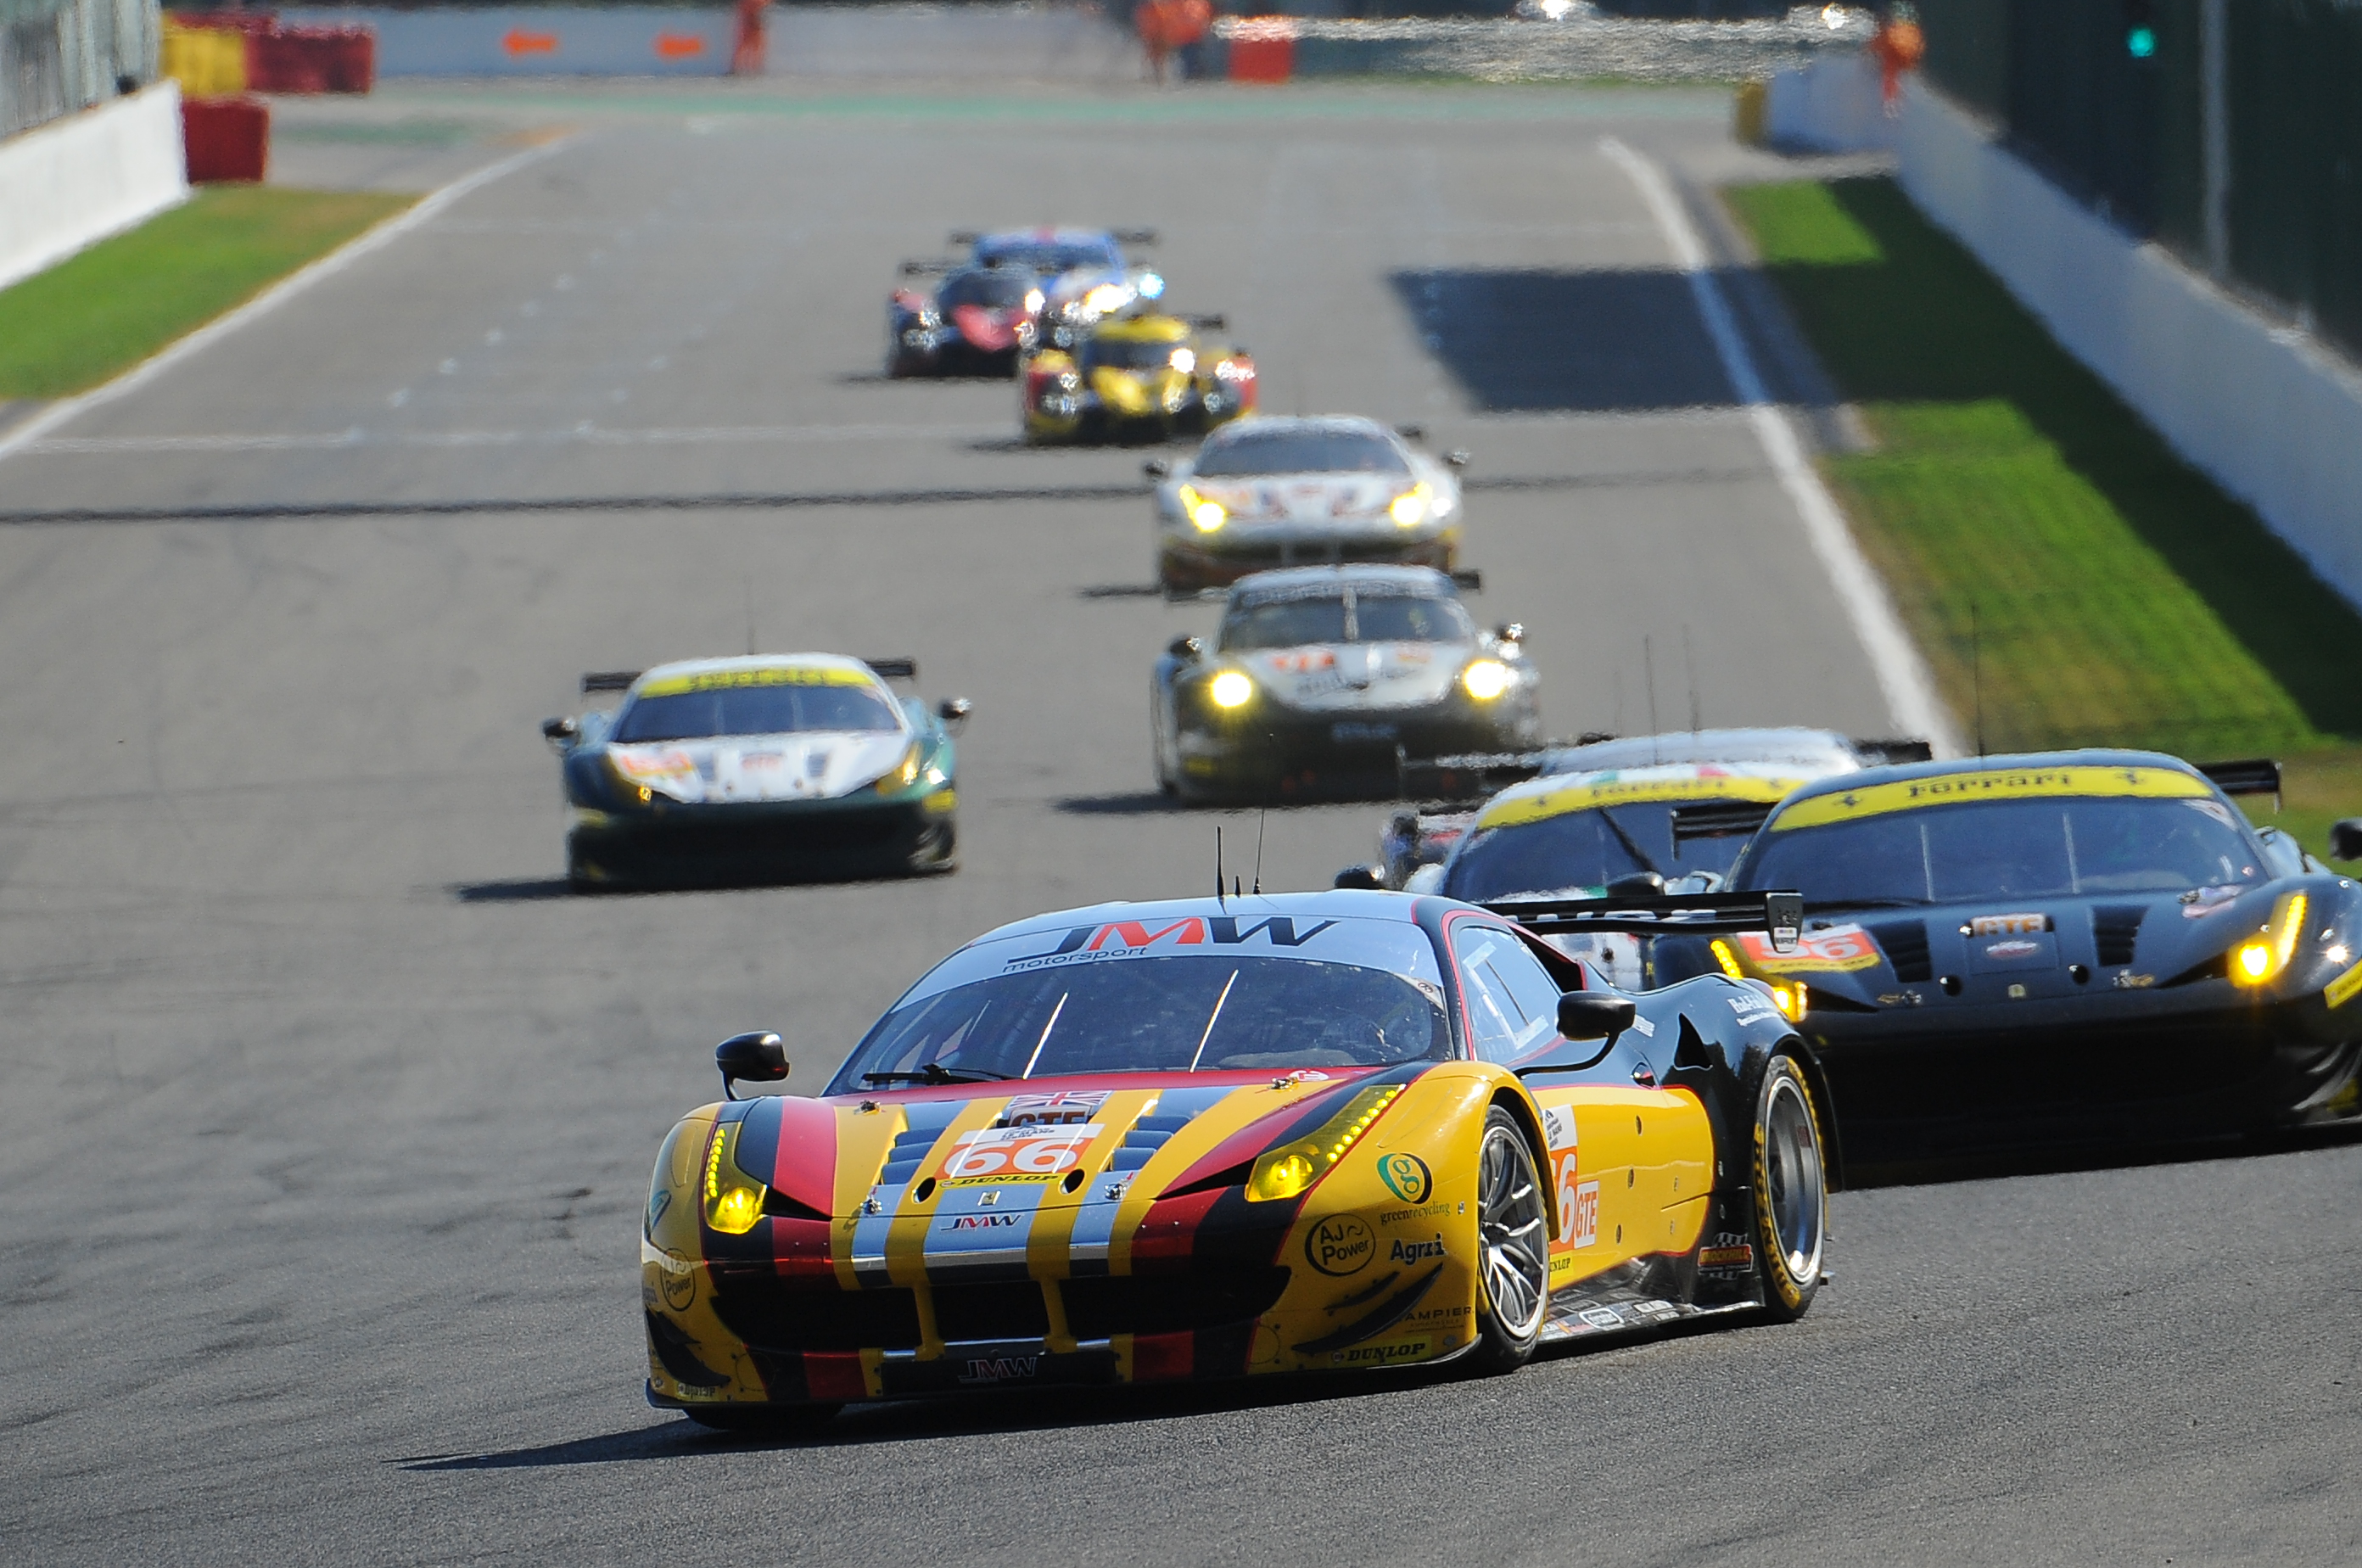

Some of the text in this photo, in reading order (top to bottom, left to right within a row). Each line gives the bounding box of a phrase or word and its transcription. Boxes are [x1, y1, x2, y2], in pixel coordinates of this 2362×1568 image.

[1007, 916, 1341, 964] JMW
[1002, 946, 1148, 973] motorsport
[943, 1138, 1084, 1178] 66
[958, 1174, 1060, 1185] DUNLOP
[1551, 1153, 1576, 1244] 6
[940, 1214, 1022, 1231] JMW
[1576, 1190, 1598, 1239] GTE
[1319, 1224, 1345, 1245] AJ
[1322, 1238, 1369, 1266] Power
[1405, 1306, 1474, 1322] AMPIER
[1347, 1342, 1426, 1362] DUNLOP
[957, 1357, 1038, 1380] JMW
